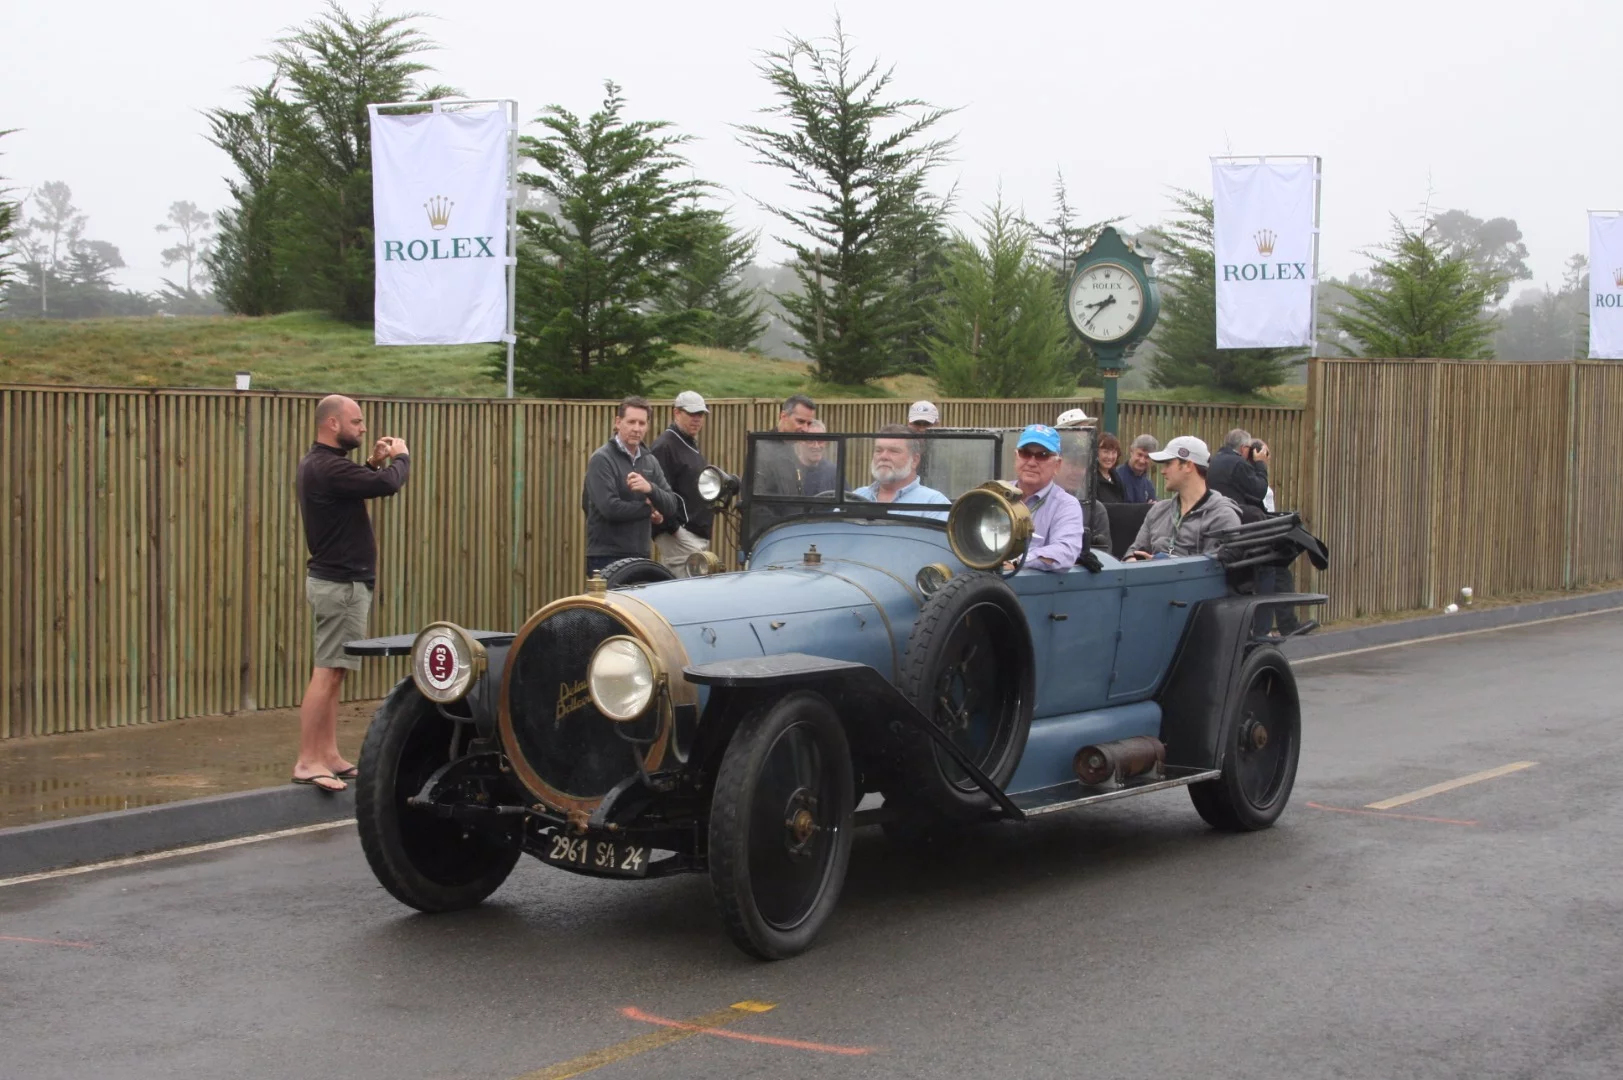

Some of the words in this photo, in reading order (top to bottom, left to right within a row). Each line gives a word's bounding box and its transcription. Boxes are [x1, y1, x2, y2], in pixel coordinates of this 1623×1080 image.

[384, 236, 495, 261] ROLEX
[1223, 262, 1306, 282] ROLEX
[1092, 282, 1122, 290] ROLEX
[435, 647, 446, 679] L1-03
[549, 834, 588, 864] 2961
[620, 845, 644, 871] 24
